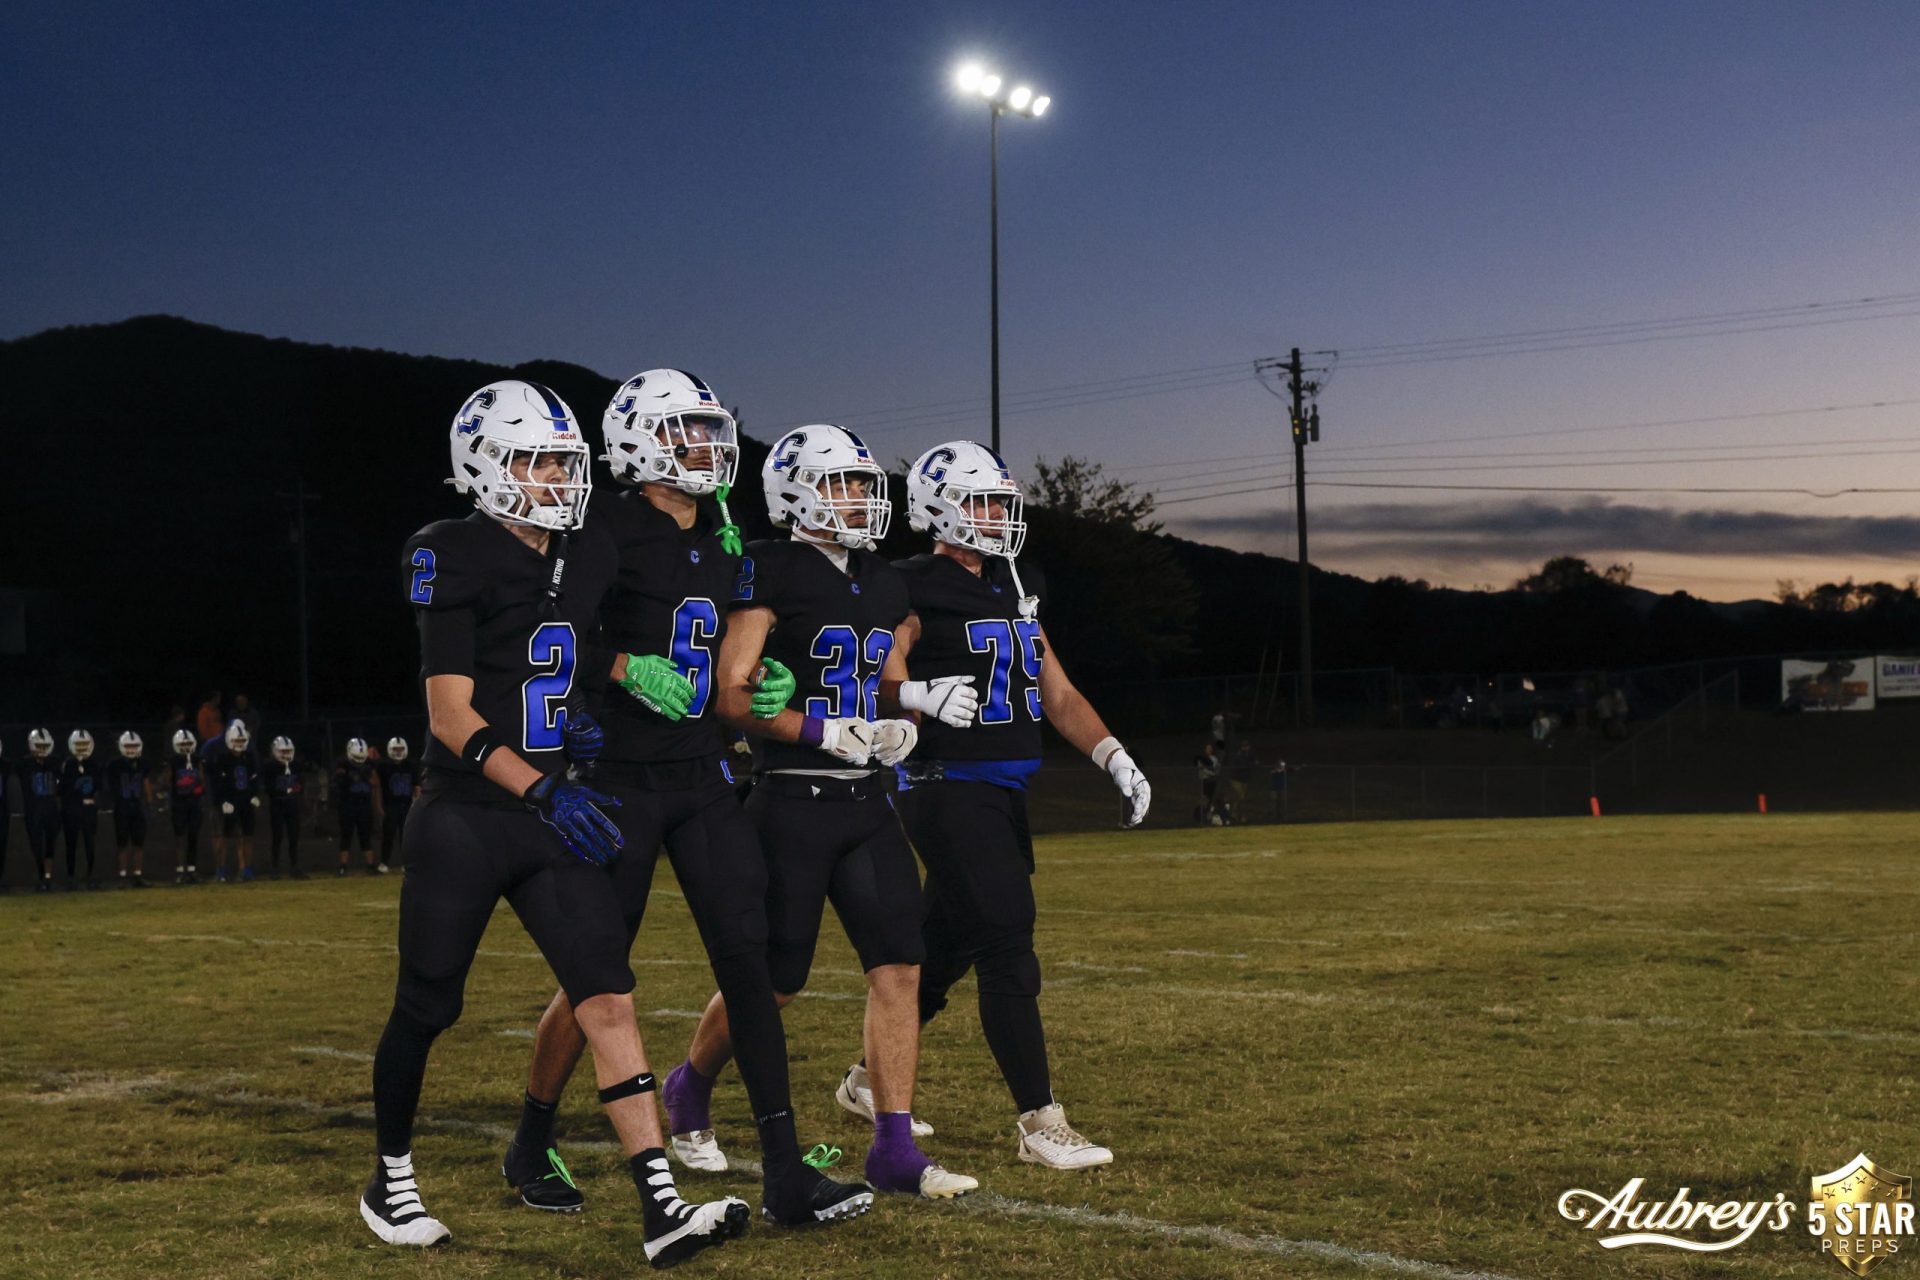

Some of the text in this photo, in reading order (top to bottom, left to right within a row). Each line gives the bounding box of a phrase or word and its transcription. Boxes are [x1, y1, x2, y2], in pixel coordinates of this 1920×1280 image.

[457, 389, 496, 437] C
[773, 431, 807, 472] C
[920, 447, 957, 486] C
[410, 546, 437, 605] 2
[522, 621, 577, 752] 2
[669, 596, 719, 719] 6
[806, 624, 895, 722] 32
[965, 618, 1042, 725] 75
